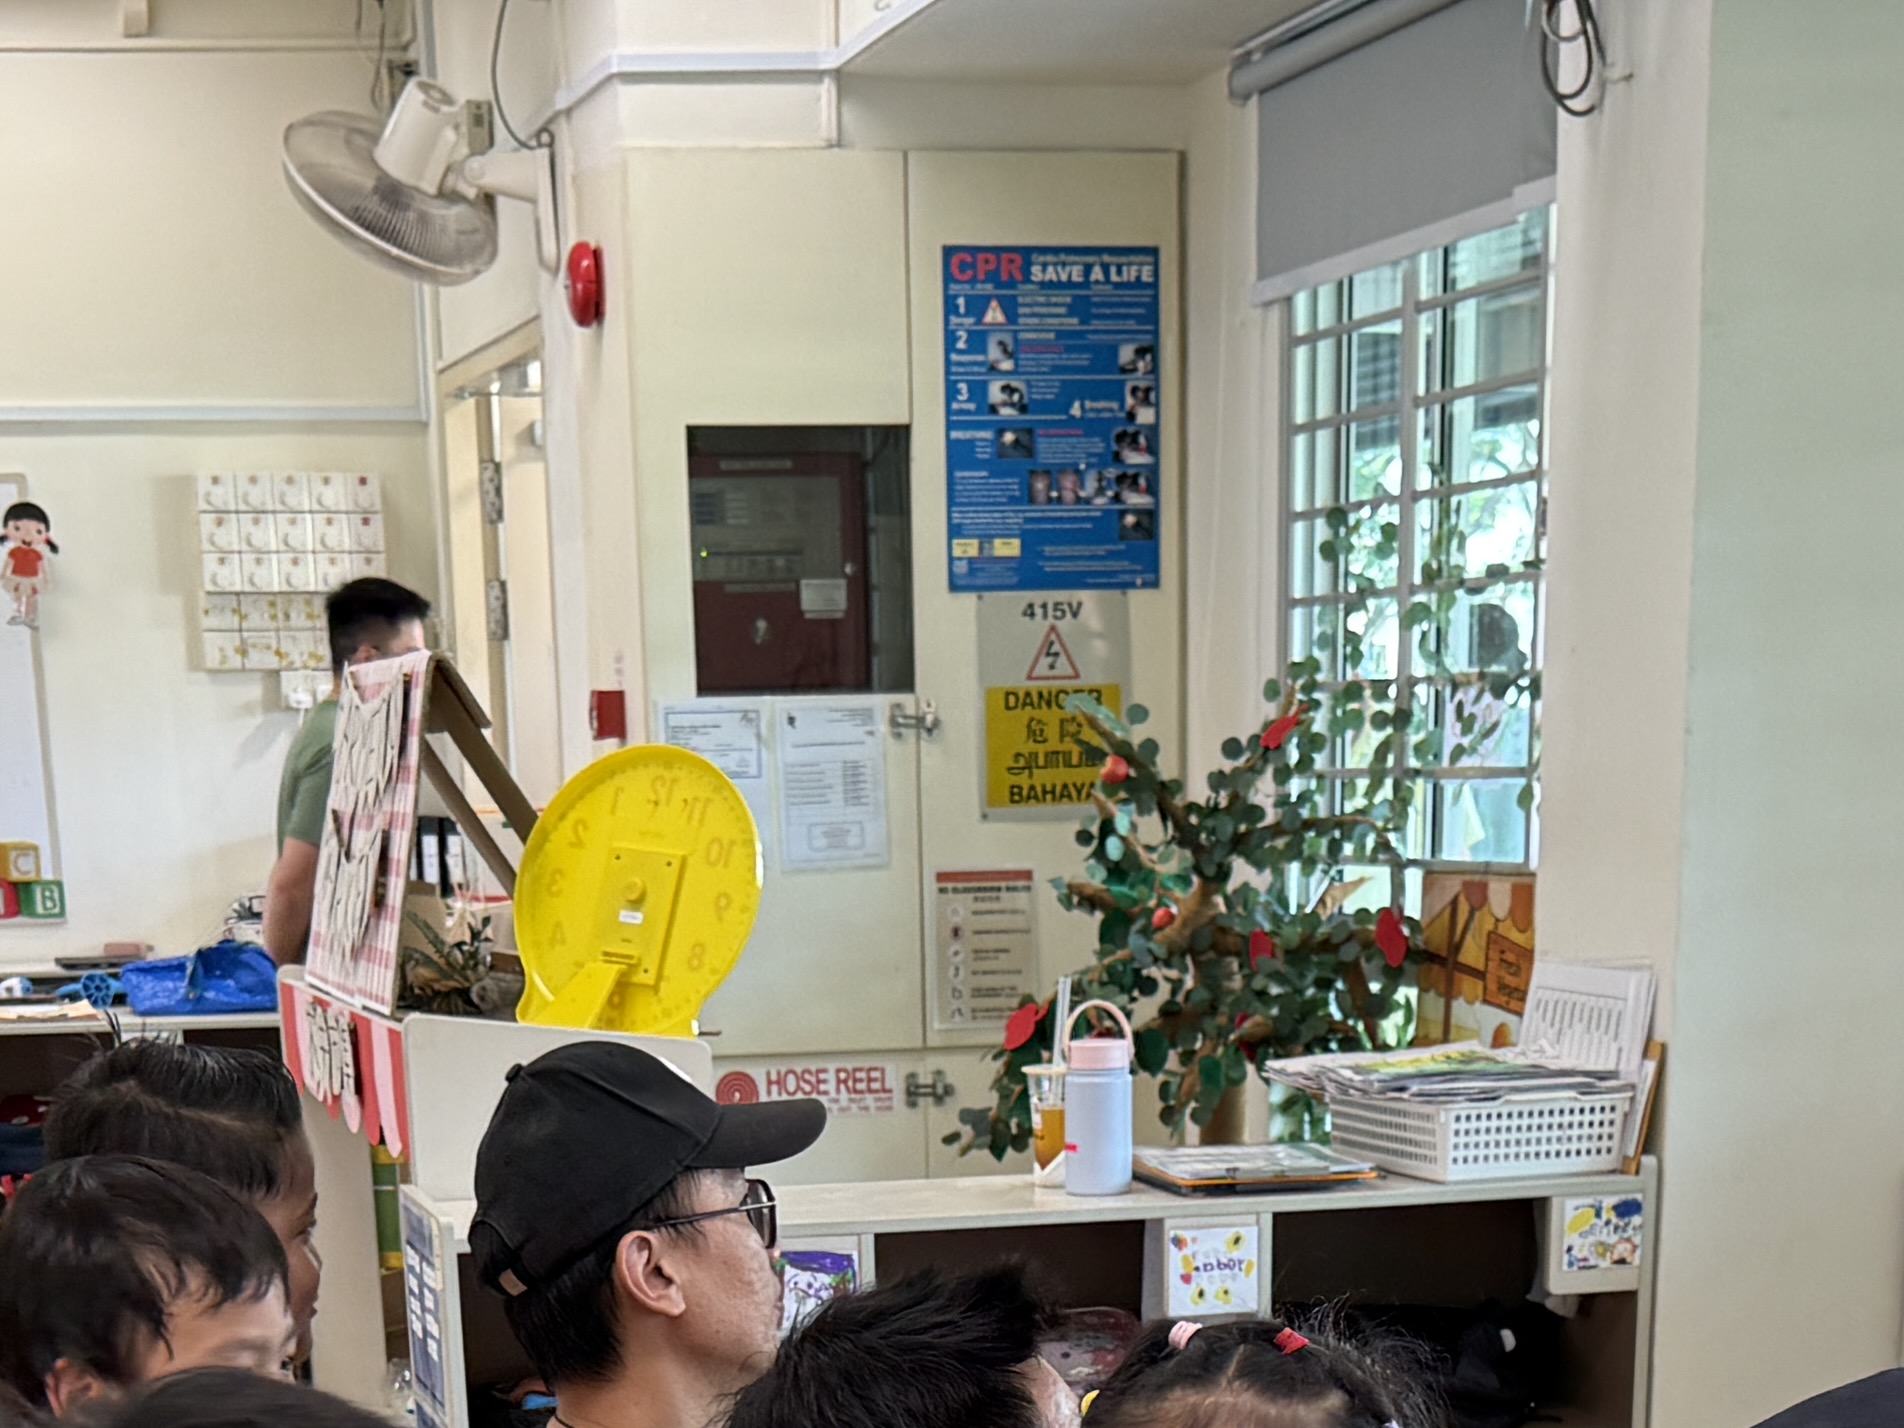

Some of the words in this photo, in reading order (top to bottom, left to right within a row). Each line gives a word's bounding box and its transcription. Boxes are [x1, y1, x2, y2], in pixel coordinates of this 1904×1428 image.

[951, 252, 1023, 282] CPR
[1030, 265, 1084, 282] SAVE
[1090, 265, 1105, 282] A
[1110, 265, 1154, 282] LIFE
[955, 296, 966, 314] 1
[955, 331, 967, 349] 2
[956, 383, 969, 401] 3
[1069, 400, 1082, 418] 4
[1021, 601, 1083, 621] 415V
[14, 853, 33, 875] C
[42, 887, 57, 911] B
[766, 1068, 830, 1097] HOSE
[835, 1067, 893, 1095] REEL
